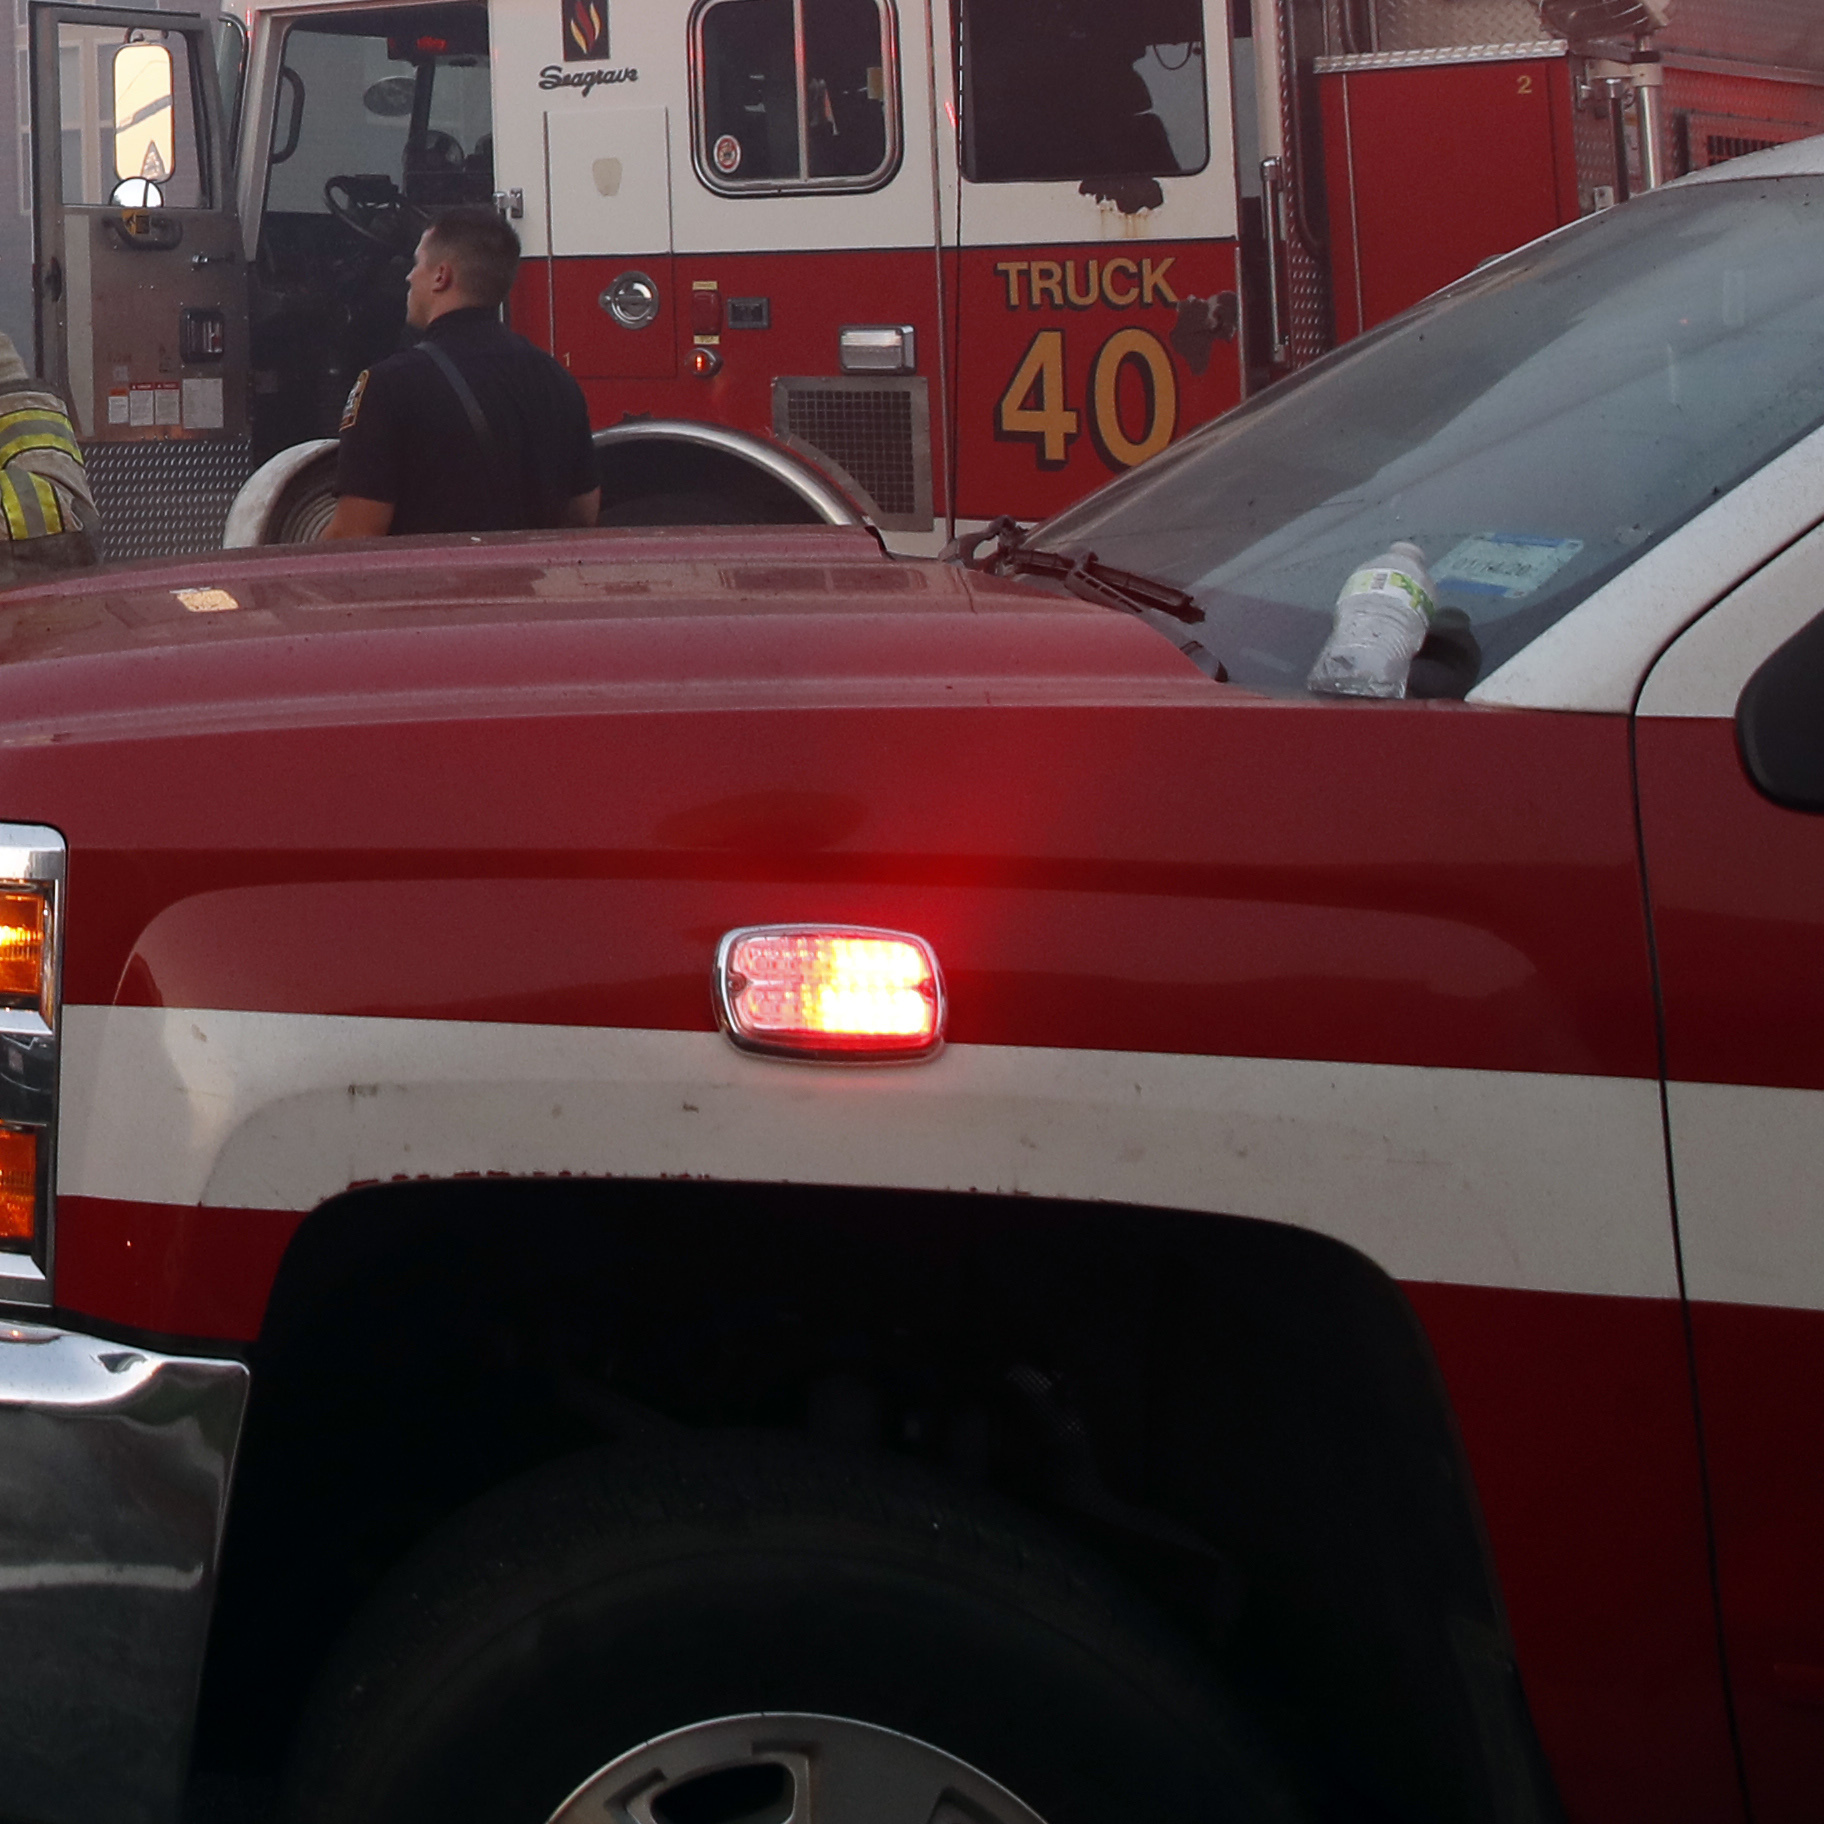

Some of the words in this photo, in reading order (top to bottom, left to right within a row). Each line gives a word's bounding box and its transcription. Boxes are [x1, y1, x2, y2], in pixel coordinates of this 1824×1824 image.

[538, 65, 639, 98] Seagrave
[1516, 75, 1533, 95] 2
[994, 256, 1180, 309] TRUCK
[997, 327, 1179, 470] 40
